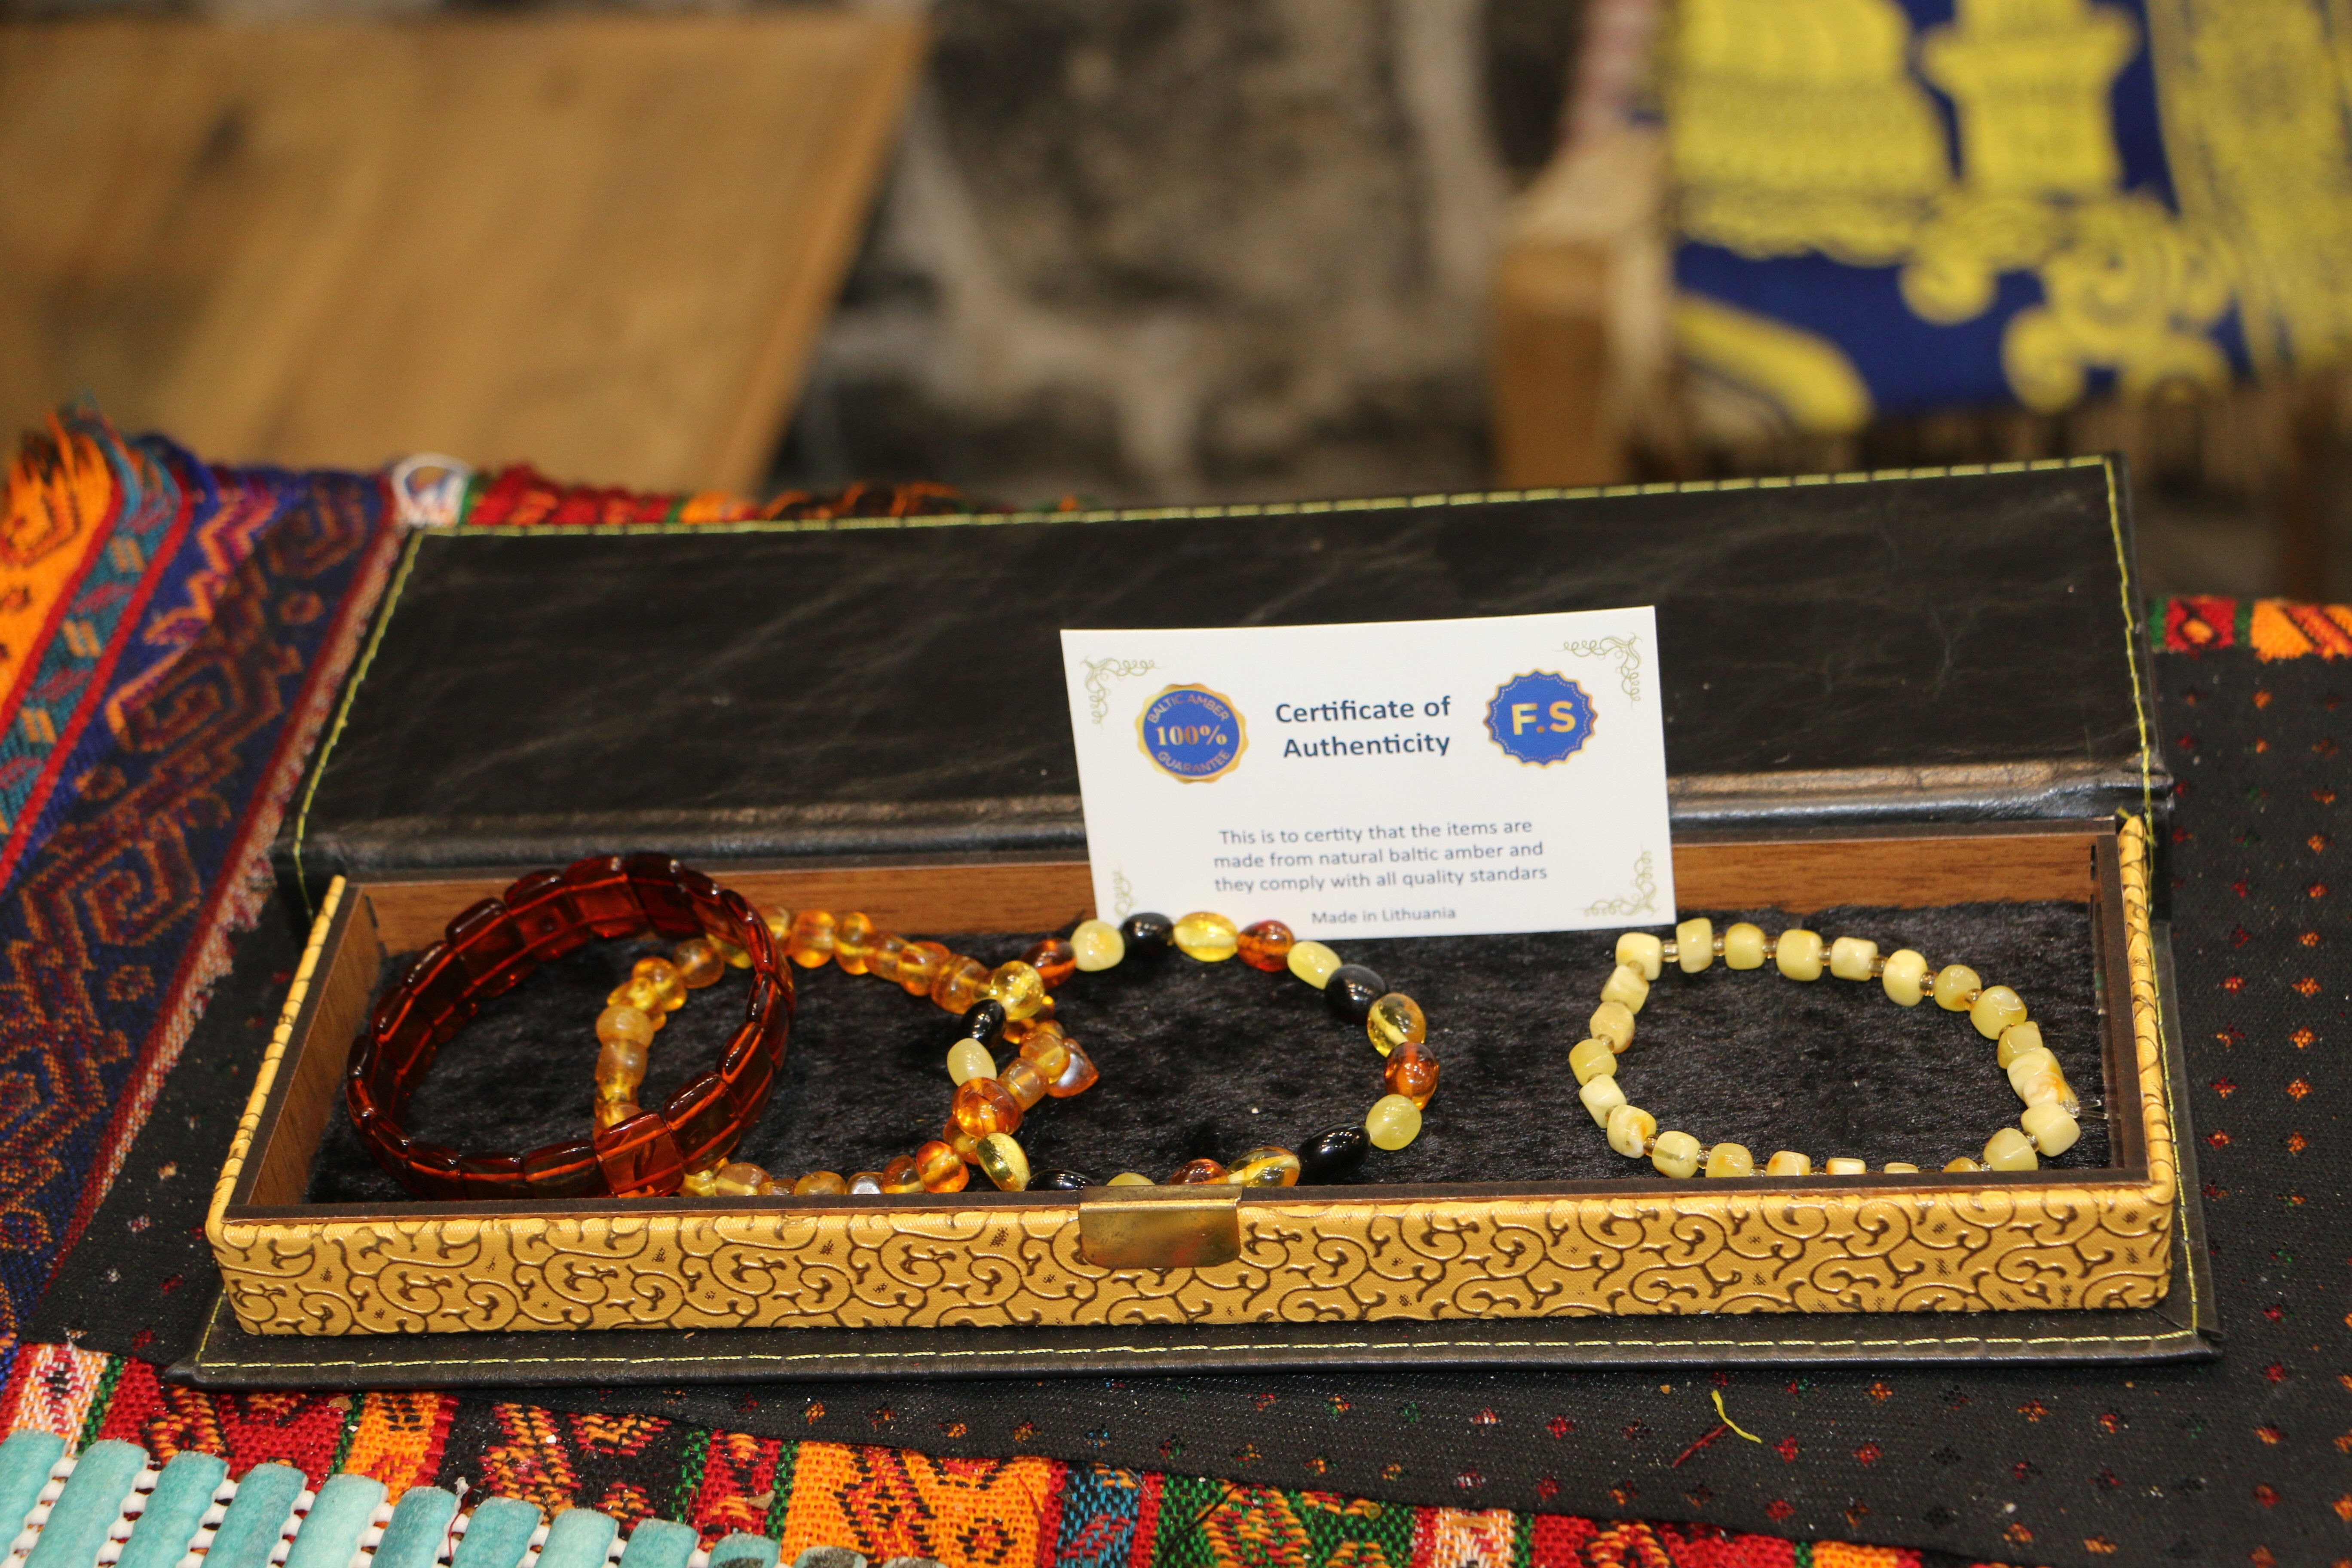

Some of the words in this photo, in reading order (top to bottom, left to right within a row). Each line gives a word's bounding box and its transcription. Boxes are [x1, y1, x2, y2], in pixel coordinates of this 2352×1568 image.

[1147, 694, 1183, 724] BALTIC
[1187, 694, 1230, 721] AMBER
[1275, 701, 1415, 723] Certificate
[1424, 696, 1451, 717] of
[1511, 701, 1577, 735] F.S
[1156, 725, 1228, 746] 100%
[1283, 733, 1450, 758] Authenticity
[1219, 830, 1256, 844] This
[1262, 830, 1275, 843] is
[1280, 831, 1298, 843] to
[1369, 825, 1405, 839] that
[1412, 824, 1441, 838] the
[1447, 822, 1497, 836] items
[1504, 821, 1532, 833] are
[1214, 853, 1264, 868] made
[1269, 852, 1313, 867] from
[1319, 849, 1383, 865] natural
[1389, 847, 1439, 862] baltic
[1444, 845, 1503, 860] amber
[1510, 841, 1544, 857] and
[1215, 878, 1254, 894] they
[1260, 875, 1325, 892] comply
[1331, 873, 1370, 888] with
[1376, 872, 1396, 886] all
[1403, 870, 1464, 887] quality
[1470, 867, 1547, 883] standars
[1311, 911, 1357, 924] Made
[1363, 910, 1376, 922] in
[1382, 908, 1455, 922] Lithuania
